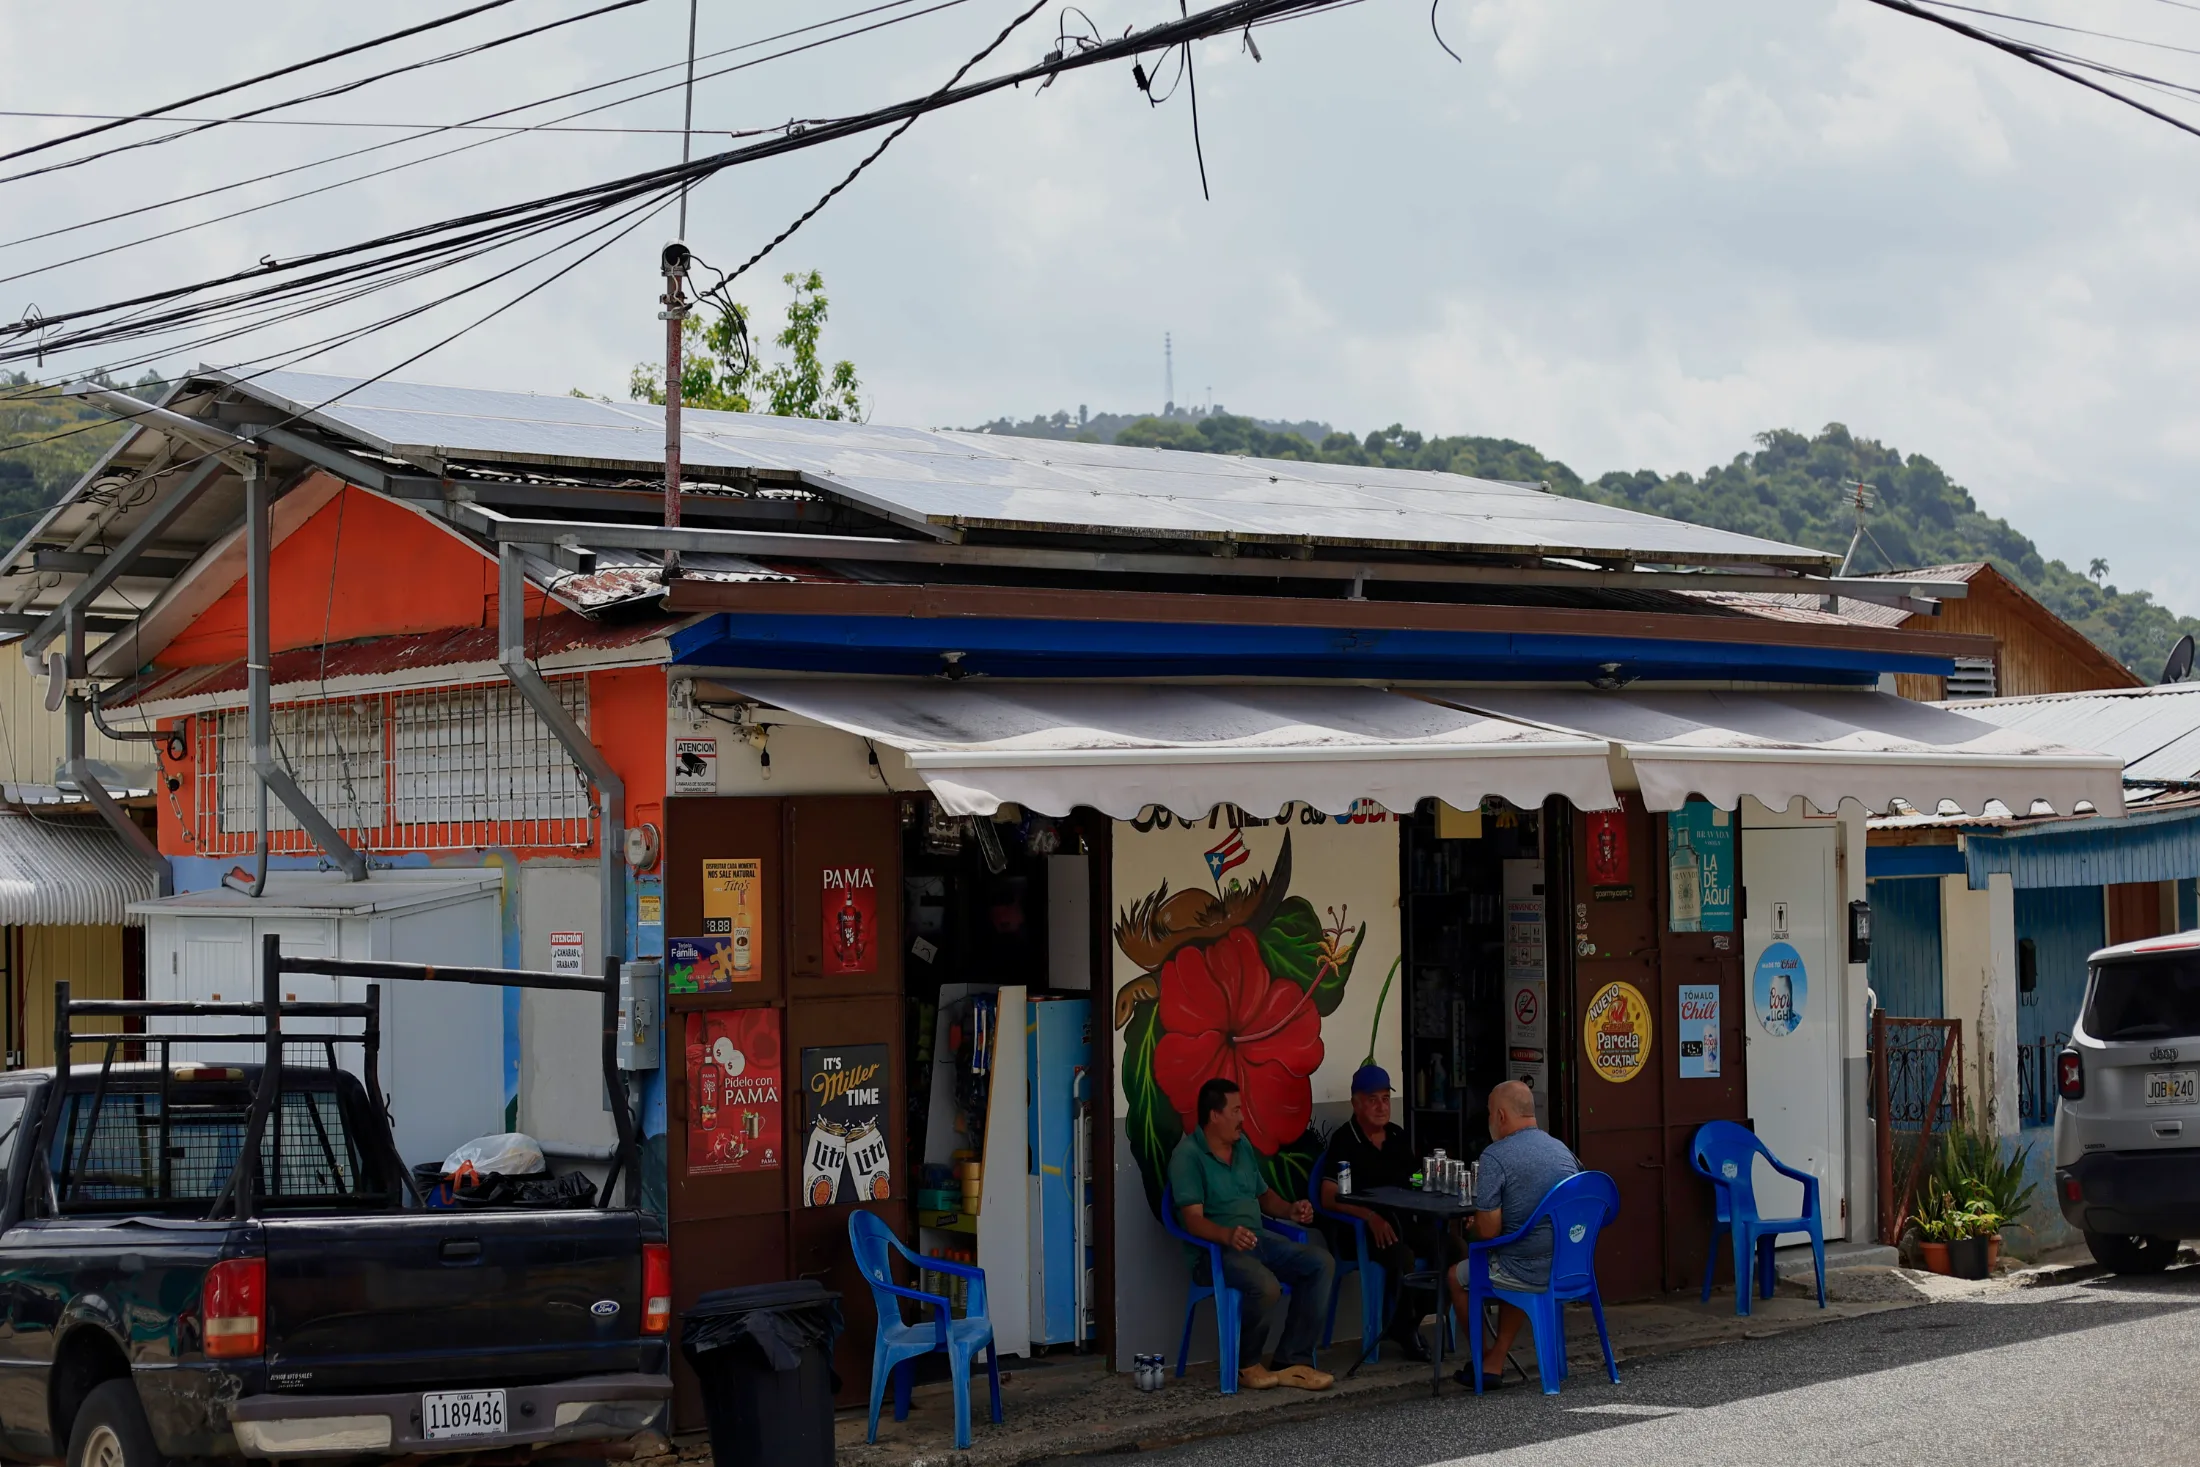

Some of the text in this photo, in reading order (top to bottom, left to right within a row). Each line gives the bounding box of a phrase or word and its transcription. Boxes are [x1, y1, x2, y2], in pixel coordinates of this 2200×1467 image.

[678, 743, 714, 752] ATENCION
[1696, 830, 1730, 839] BRAVADA
[1703, 854, 1718, 871] LA
[708, 870, 756, 878] NOS SALE NATURAL
[823, 868, 874, 890] PAMA
[1703, 872, 1718, 888] DE
[724, 880, 750, 891] Tito's
[1703, 885, 1731, 905] AQUÍ
[706, 920, 730, 932] $8.88
[551, 933, 582, 943] ATENCIÓN
[671, 948, 698, 958] Familia
[556, 960, 578, 968] GRABANDO
[1781, 958, 1798, 969] Chill
[1684, 990, 1714, 1000] TÓMALO
[1589, 984, 1620, 1022] NUEVO
[1681, 1001, 1718, 1020] Chill
[1597, 1054, 1639, 1068] COCKTAIL
[2150, 1047, 2178, 1061] Jeep
[823, 1057, 842, 1070] IT'S
[724, 1077, 773, 1088] Pídelo con
[811, 1063, 880, 1107] Miller
[2148, 1080, 2194, 1098] JQB 240
[725, 1087, 779, 1106] PAMA
[846, 1088, 879, 1106] TIME
[812, 1140, 844, 1172] Lite
[853, 1140, 885, 1176] Lite
[598, 1304, 614, 1313] Ford
[299, 1372, 312, 1380] SALES
[431, 1401, 502, 1429] 1189436
